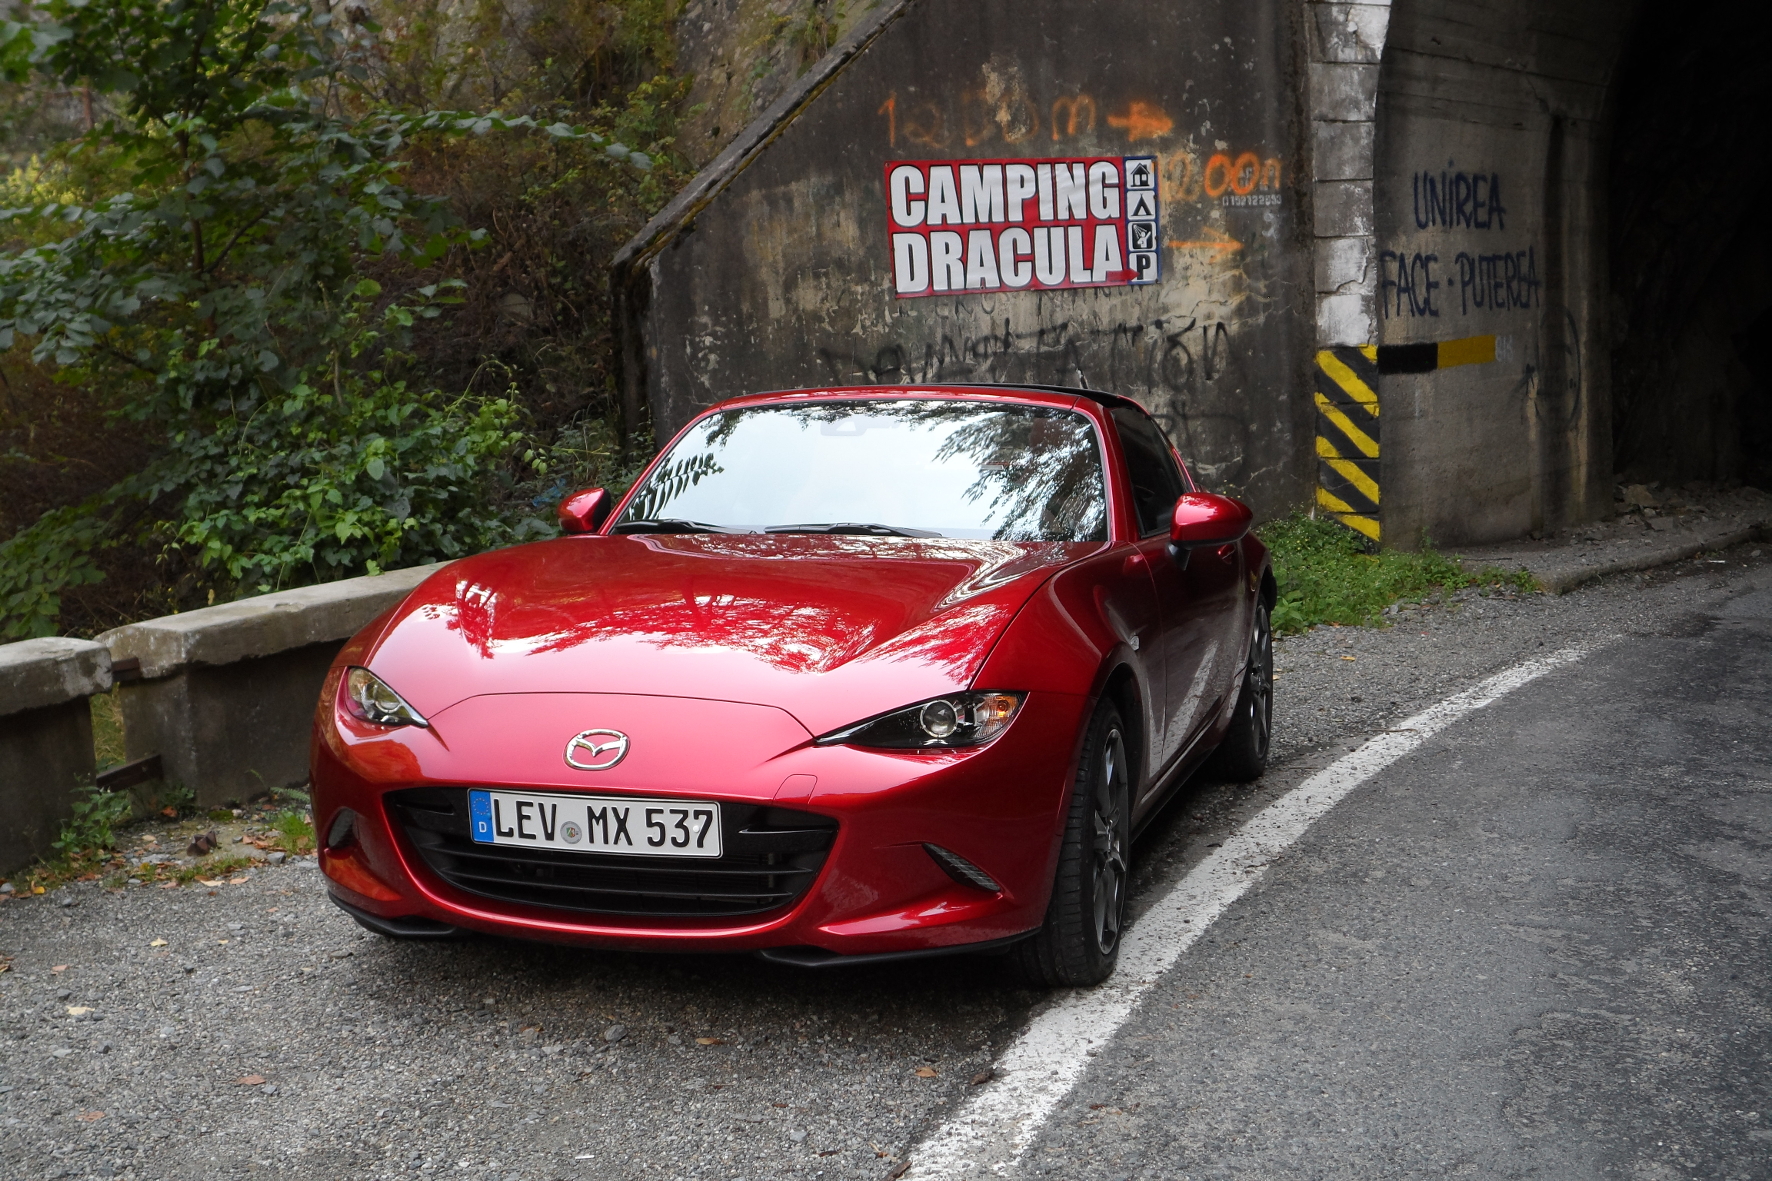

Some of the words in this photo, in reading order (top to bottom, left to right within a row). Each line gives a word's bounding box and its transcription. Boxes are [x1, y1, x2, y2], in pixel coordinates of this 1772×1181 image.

[889, 160, 1121, 227] CAMPING
[891, 223, 1125, 293] DRACULA
[1136, 253, 1152, 281] P
[1379, 250, 1440, 319] FACE
[1454, 245, 1541, 316] PUTEREA
[478, 821, 487, 833] D
[493, 798, 557, 841] LEV
[586, 805, 633, 846] MX
[645, 808, 713, 849] 537
